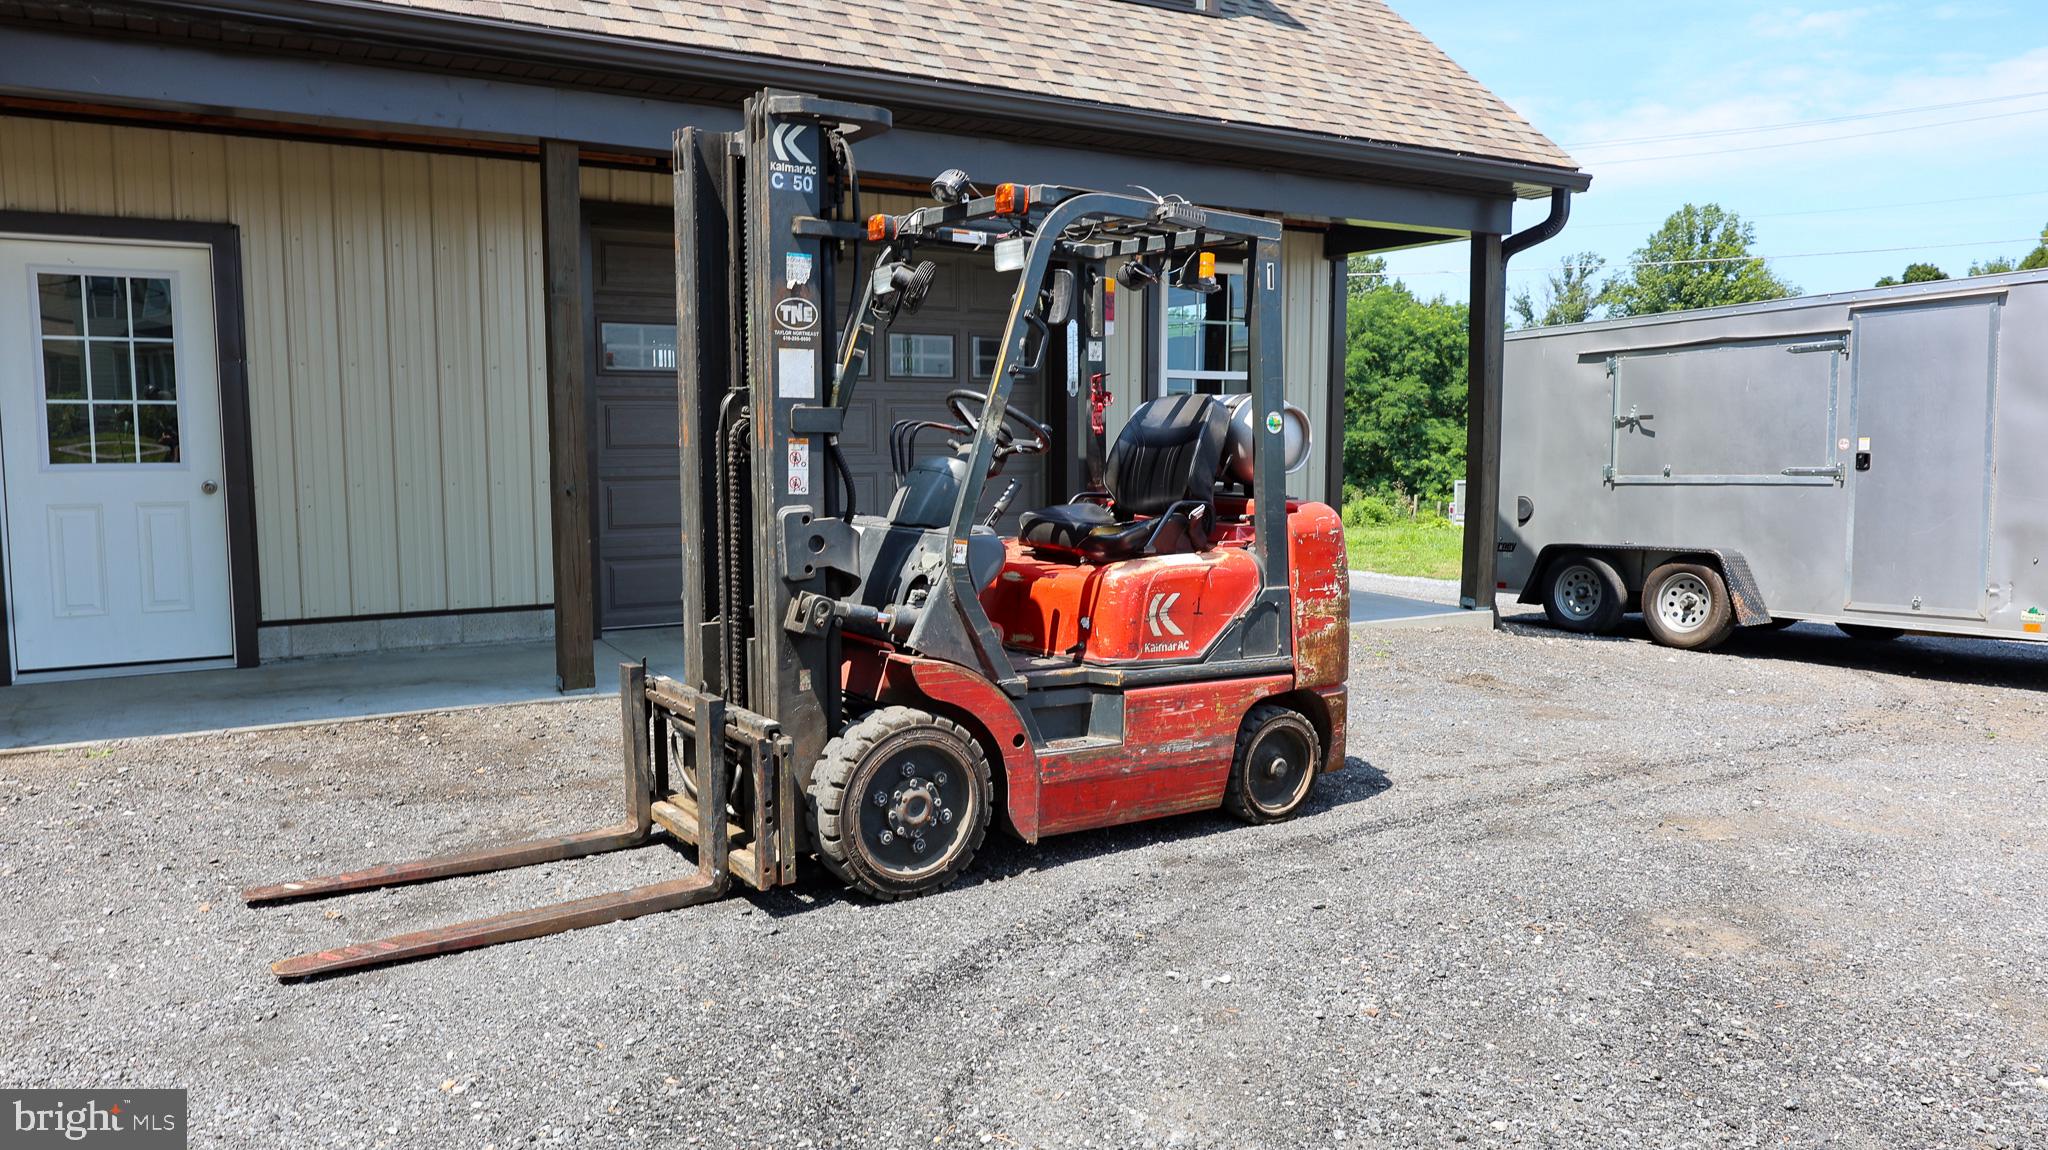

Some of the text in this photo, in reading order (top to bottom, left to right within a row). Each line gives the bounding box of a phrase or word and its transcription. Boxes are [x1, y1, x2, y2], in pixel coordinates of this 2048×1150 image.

[770, 162, 816, 175] Kalmar AC
[772, 172, 813, 192] C 50
[1267, 263, 1274, 289] 1
[780, 303, 812, 324] TNE
